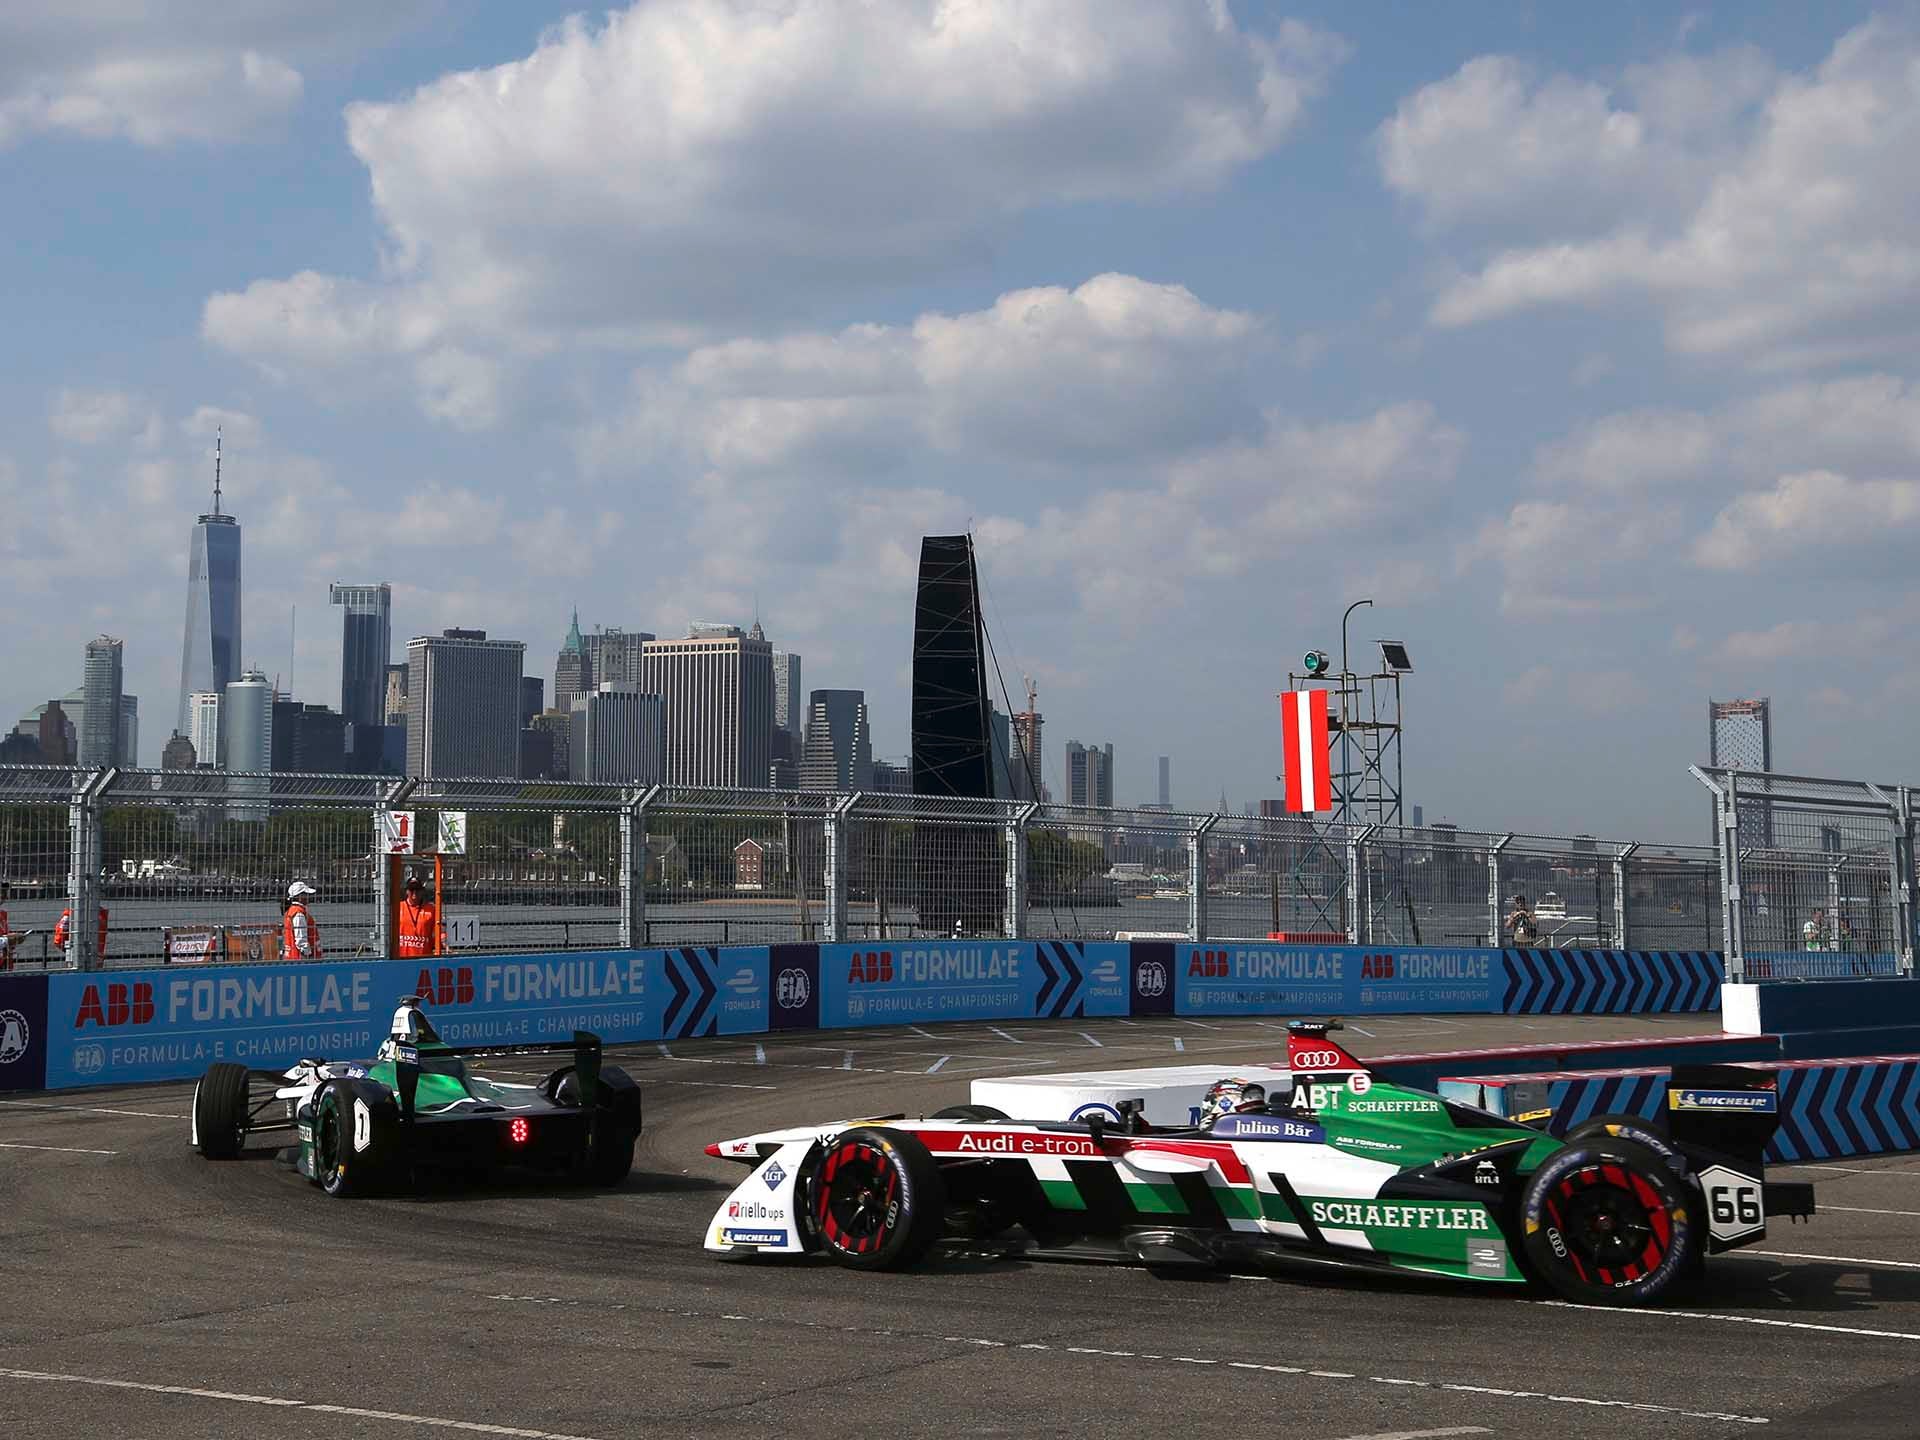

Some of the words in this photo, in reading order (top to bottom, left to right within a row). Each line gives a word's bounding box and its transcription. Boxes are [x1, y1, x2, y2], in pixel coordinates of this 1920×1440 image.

[452, 919, 474, 942] 1.1
[848, 951, 893, 984] ABB
[1188, 951, 1229, 977] ABB
[1361, 955, 1394, 979] ABB
[415, 967, 475, 1006] ABB
[75, 983, 155, 1029] ABB
[939, 994, 1019, 1010] CHAMPIONSHIP
[538, 1012, 644, 1033] CHAMPIONSHIP
[236, 1032, 371, 1057] CHAMPIONSHIP
[1353, 1076, 1366, 1092] E
[1291, 1084, 1343, 1109] ABT
[1349, 1100, 1439, 1112] SCHAEFFLER
[1699, 1096, 1767, 1107] MICHELIN
[1235, 1120, 1279, 1135] Julius
[1284, 1123, 1314, 1138] Bär
[732, 1143, 749, 1152] WE
[958, 1133, 1014, 1151] Audi
[1021, 1137, 1095, 1153] e-tron
[765, 1171, 783, 1181] LGT
[740, 1201, 767, 1218] riello
[768, 1210, 785, 1221] ups
[1312, 1201, 1489, 1230] SCHAEFFLER
[1711, 1186, 1761, 1224] 66
[733, 1233, 782, 1242] MICHELIN
